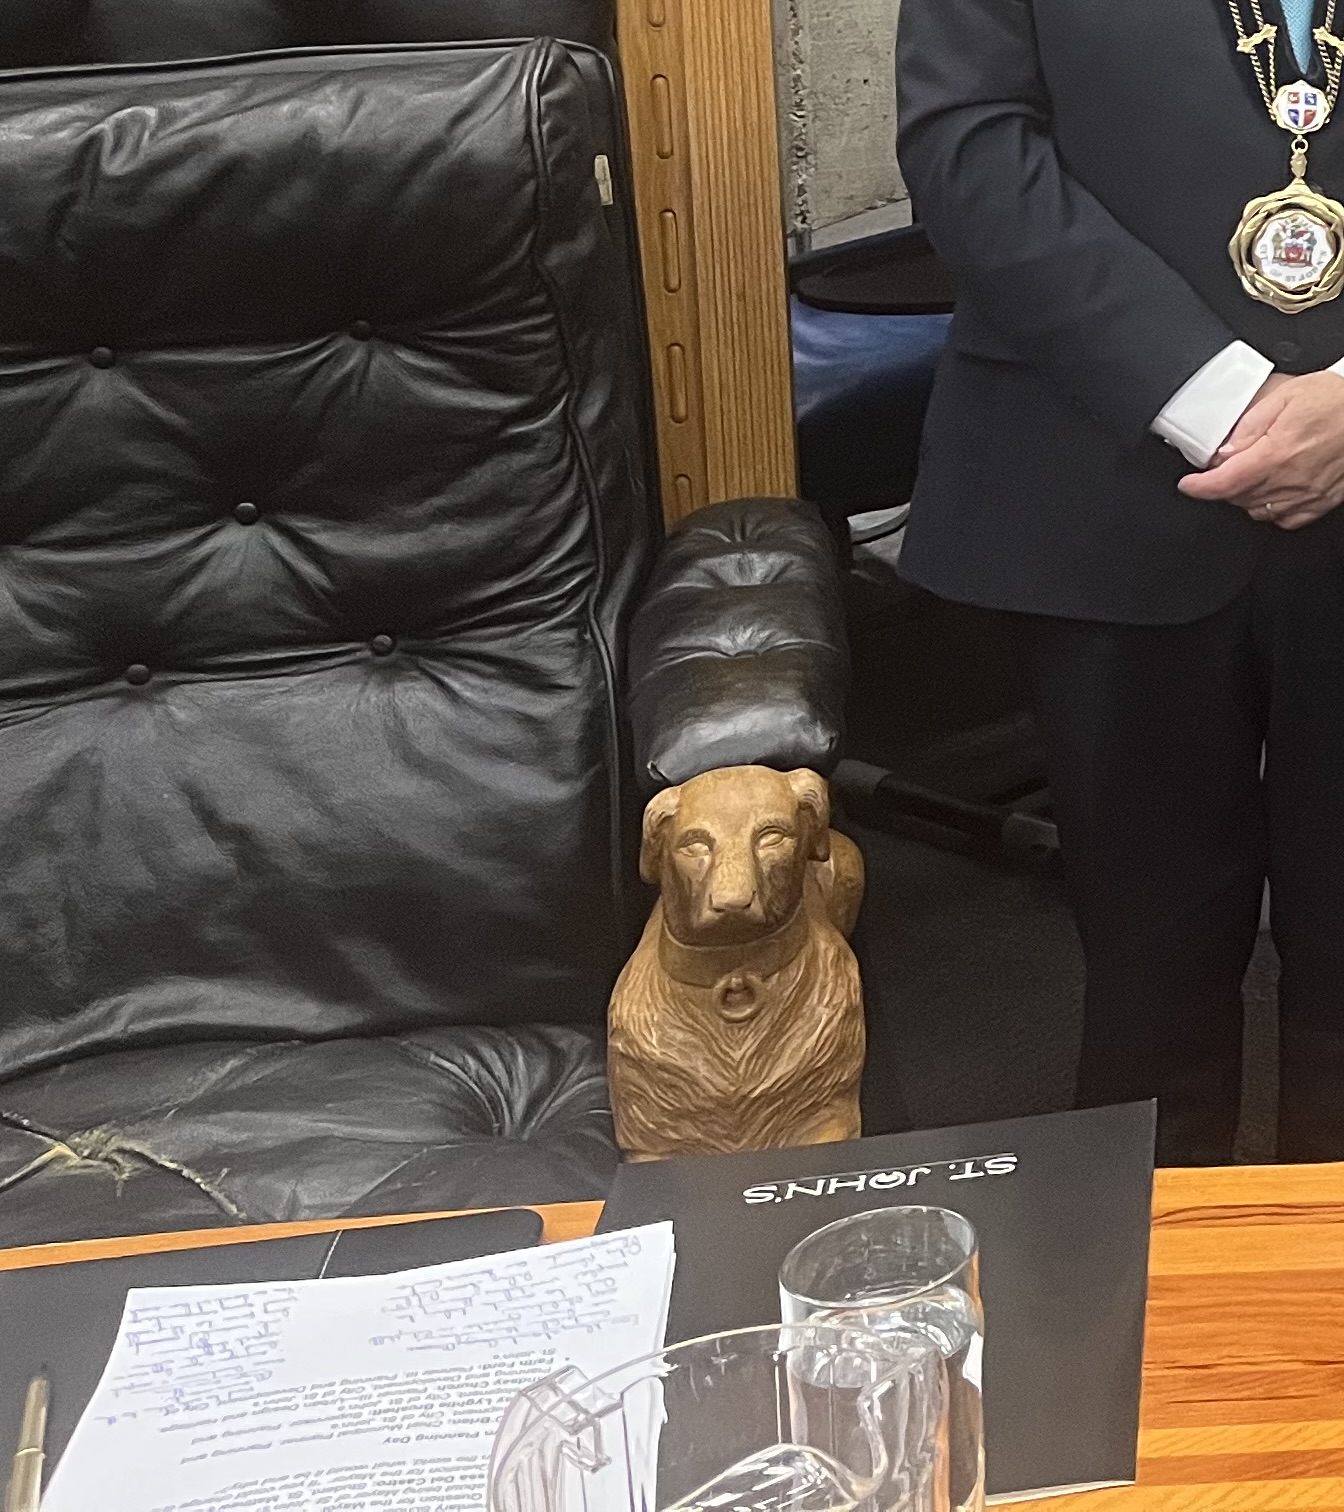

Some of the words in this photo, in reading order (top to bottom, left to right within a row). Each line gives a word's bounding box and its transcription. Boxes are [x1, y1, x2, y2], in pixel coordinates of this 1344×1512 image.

[948, 1157, 1018, 1182] ST.
[742, 1166, 931, 1204] JOHN'S
[520, 1357, 555, 1367] Faith
[383, 1435, 411, 1444] Day
[415, 1431, 480, 1442] Planning
